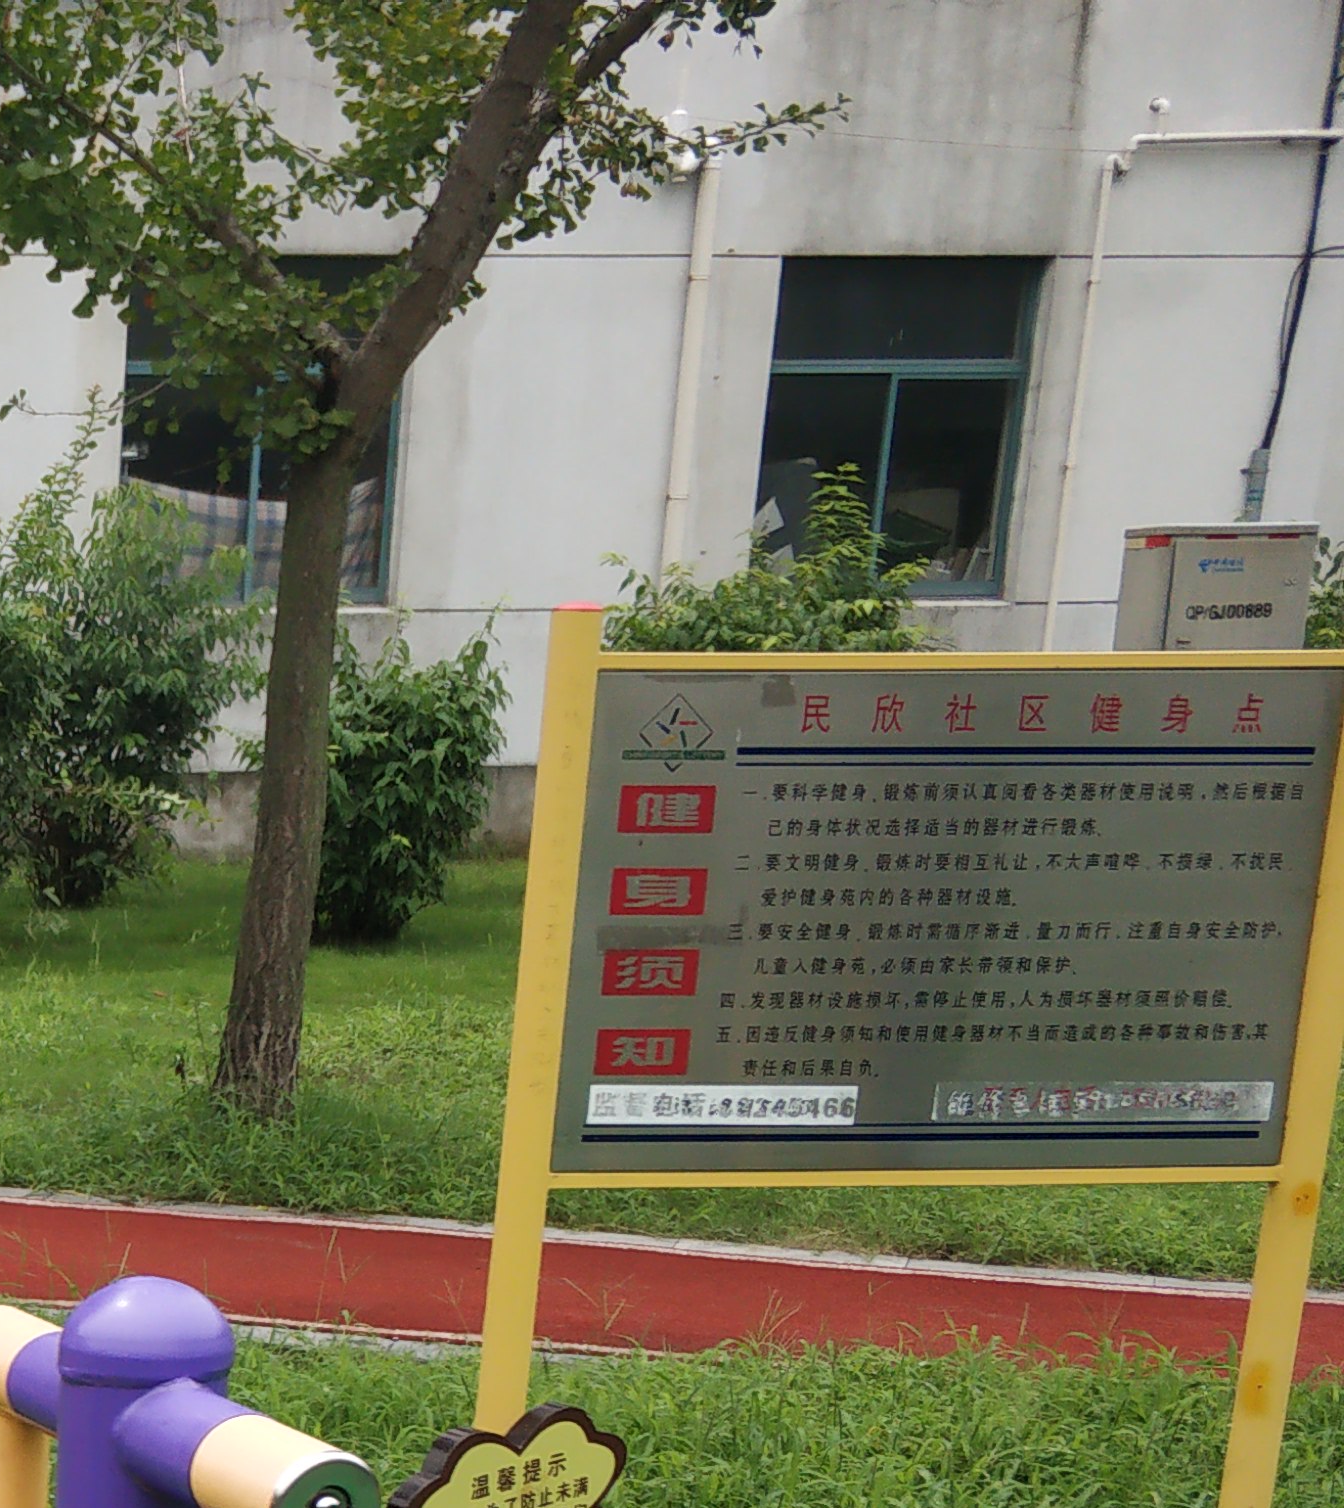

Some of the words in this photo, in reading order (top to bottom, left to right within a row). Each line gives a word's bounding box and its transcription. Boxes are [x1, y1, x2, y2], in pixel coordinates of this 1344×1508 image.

[800, 692, 1265, 735] 民欣社区健身点
[471, 1452, 567, 1500] 温馨提示
